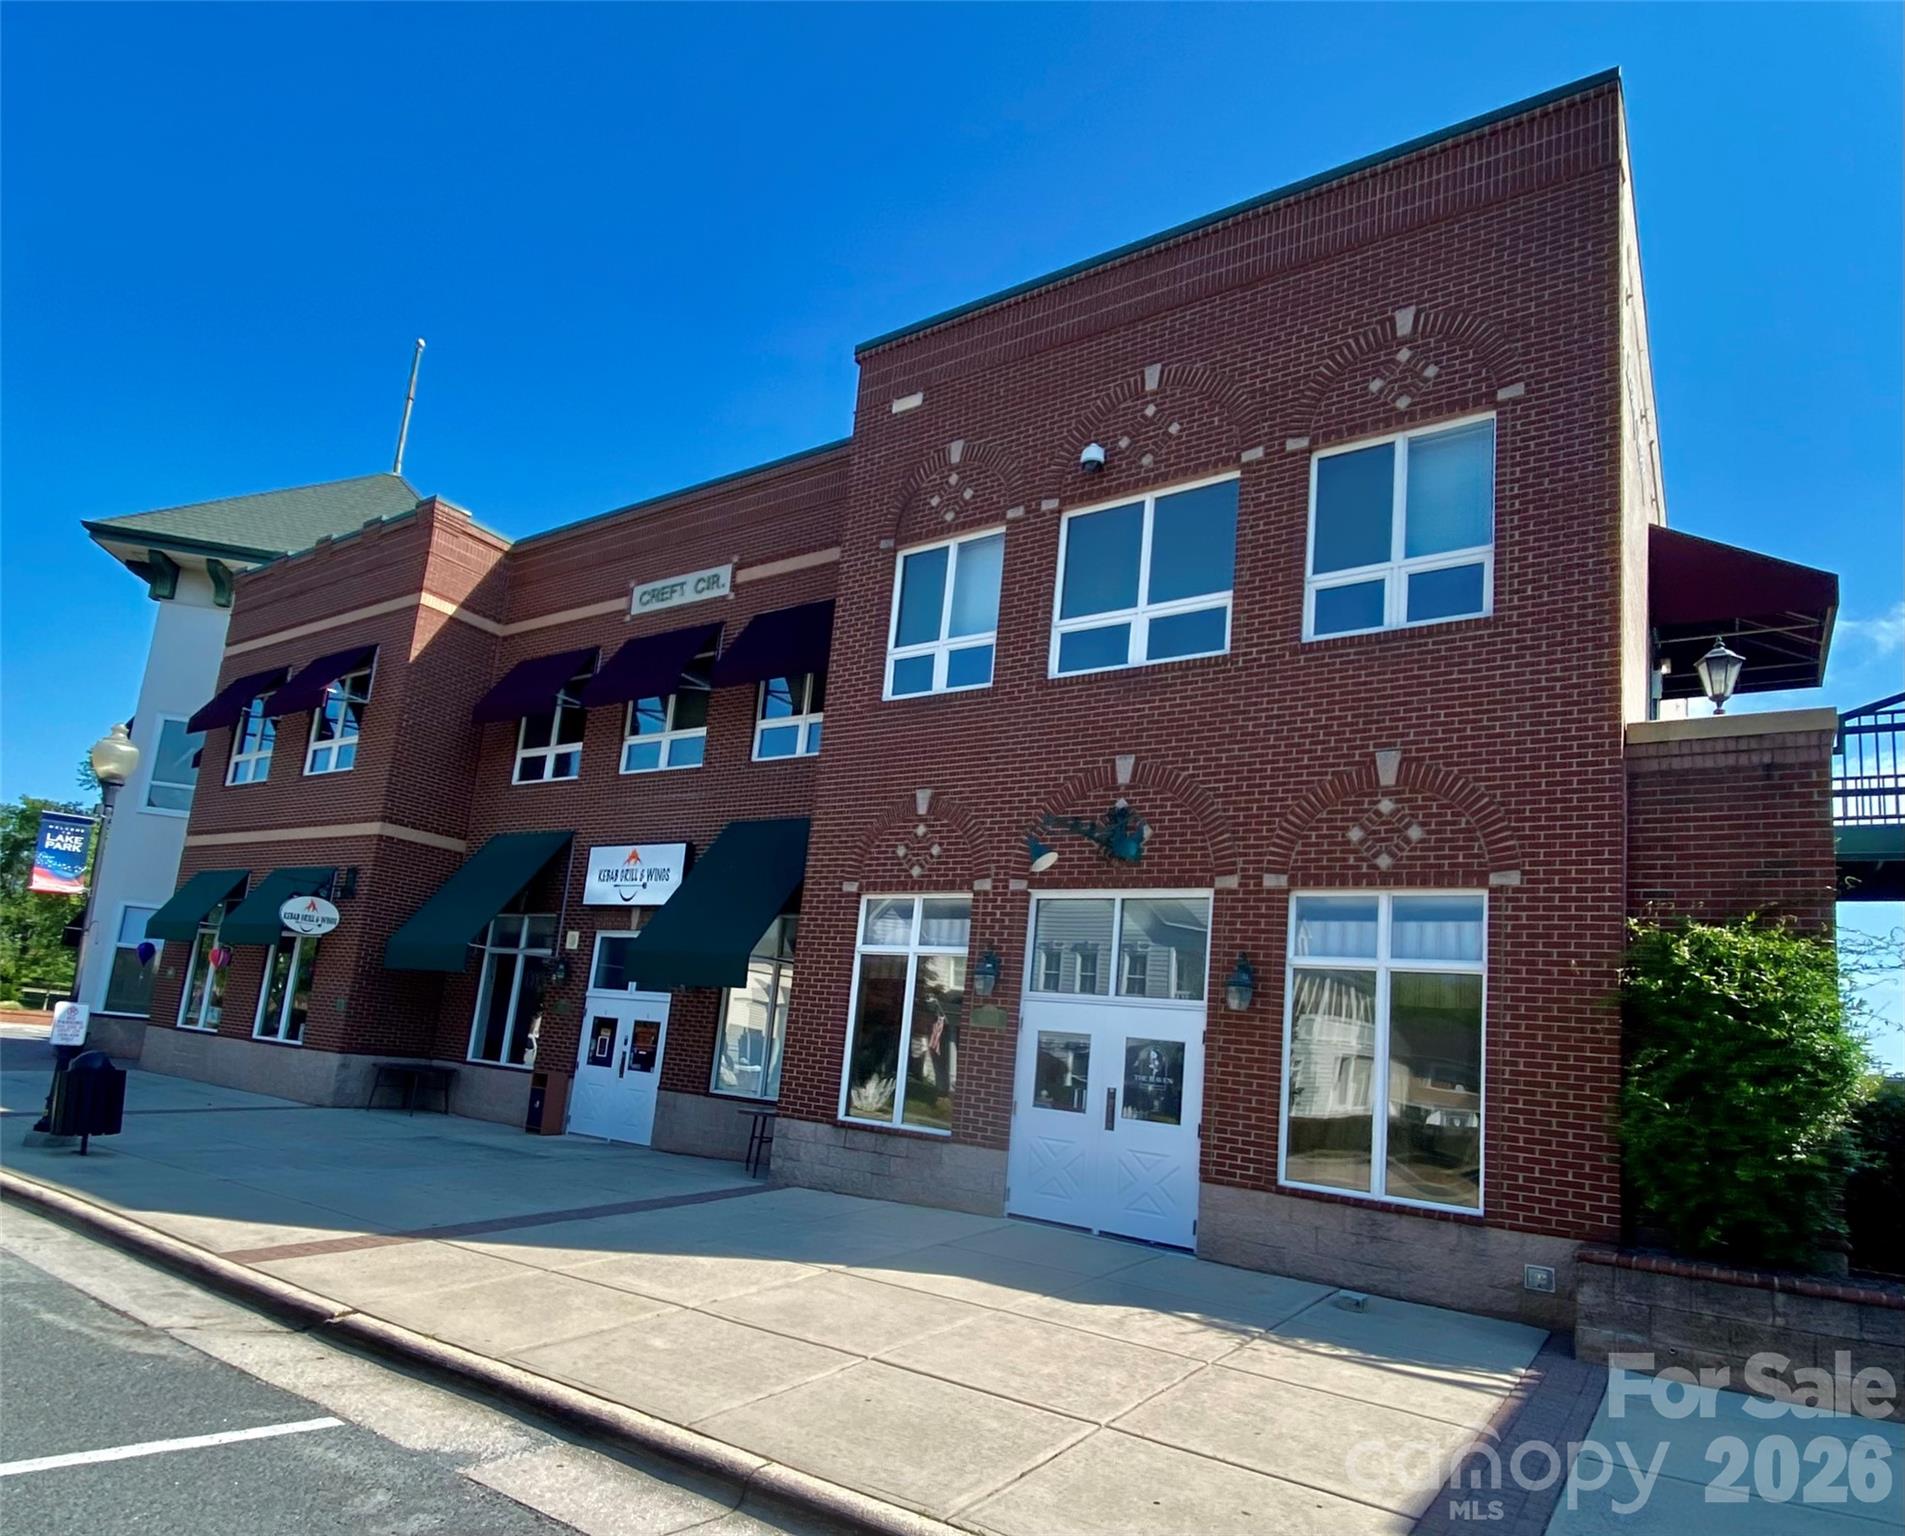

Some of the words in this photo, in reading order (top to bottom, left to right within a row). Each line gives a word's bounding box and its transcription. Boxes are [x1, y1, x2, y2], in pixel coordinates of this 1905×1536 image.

[639, 581, 687, 606] CREFT
[694, 573, 725, 594] CIR.
[46, 832, 84, 845] LAKE
[44, 840, 83, 853] PARK
[597, 869, 619, 882] KEBAB
[646, 867, 670, 882] WINGS
